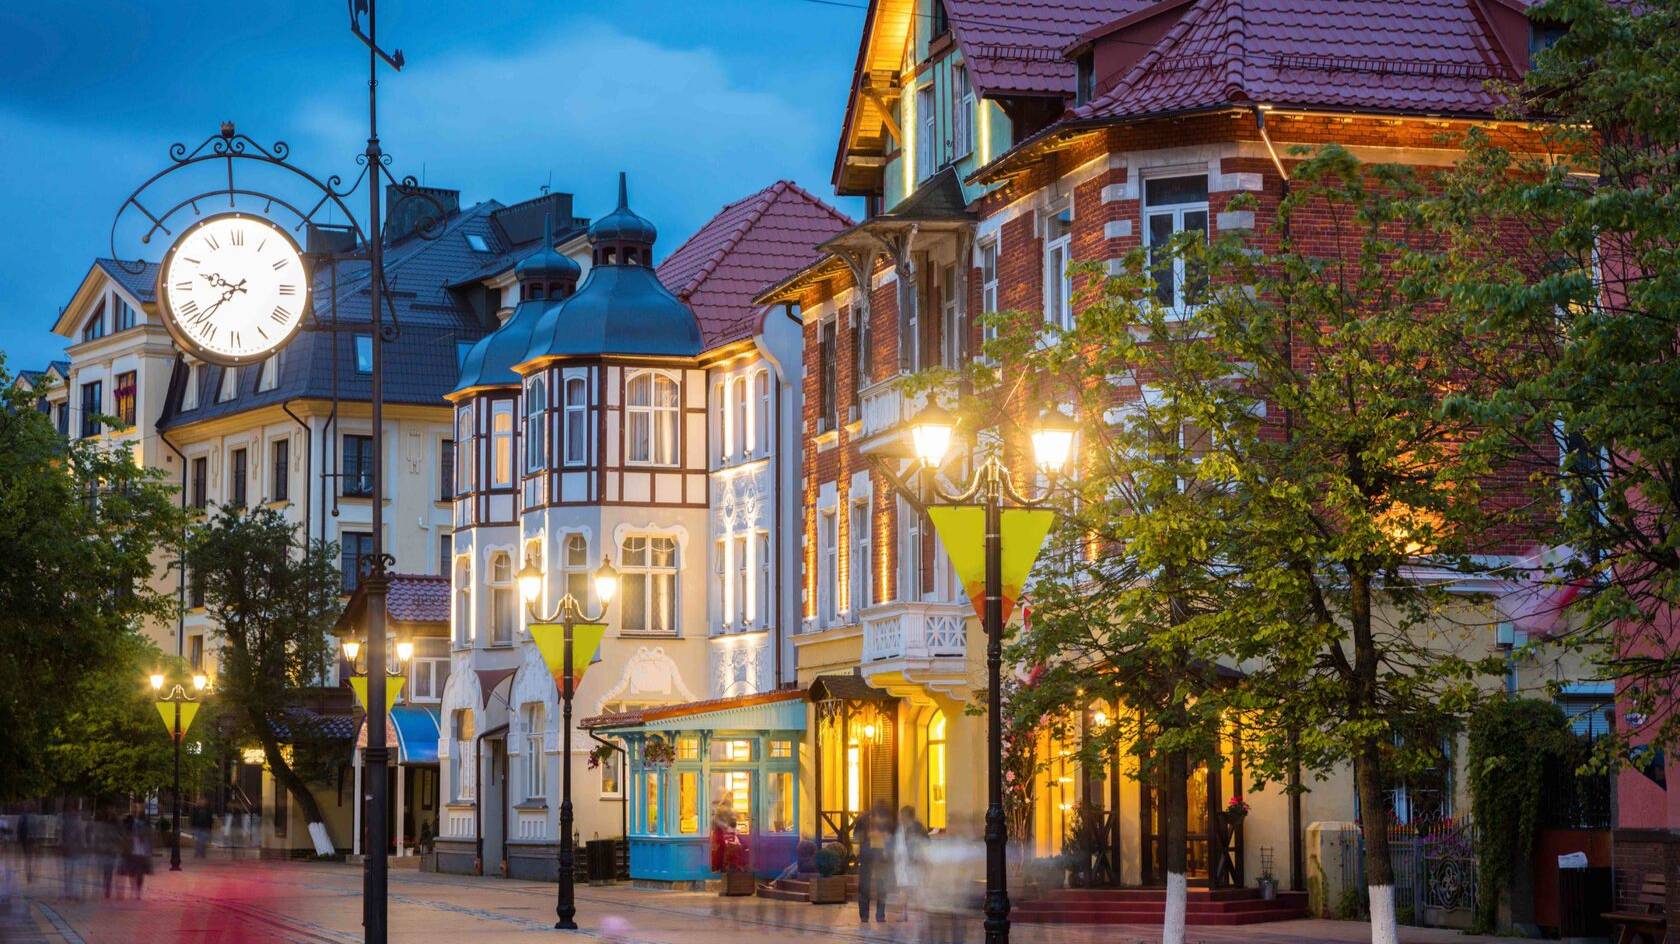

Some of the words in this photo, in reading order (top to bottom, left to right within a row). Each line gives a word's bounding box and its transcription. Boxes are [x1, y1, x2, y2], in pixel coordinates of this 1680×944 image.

[272, 258, 289, 271] II
[279, 284, 296, 296] III
[270, 305, 292, 326] IIII
